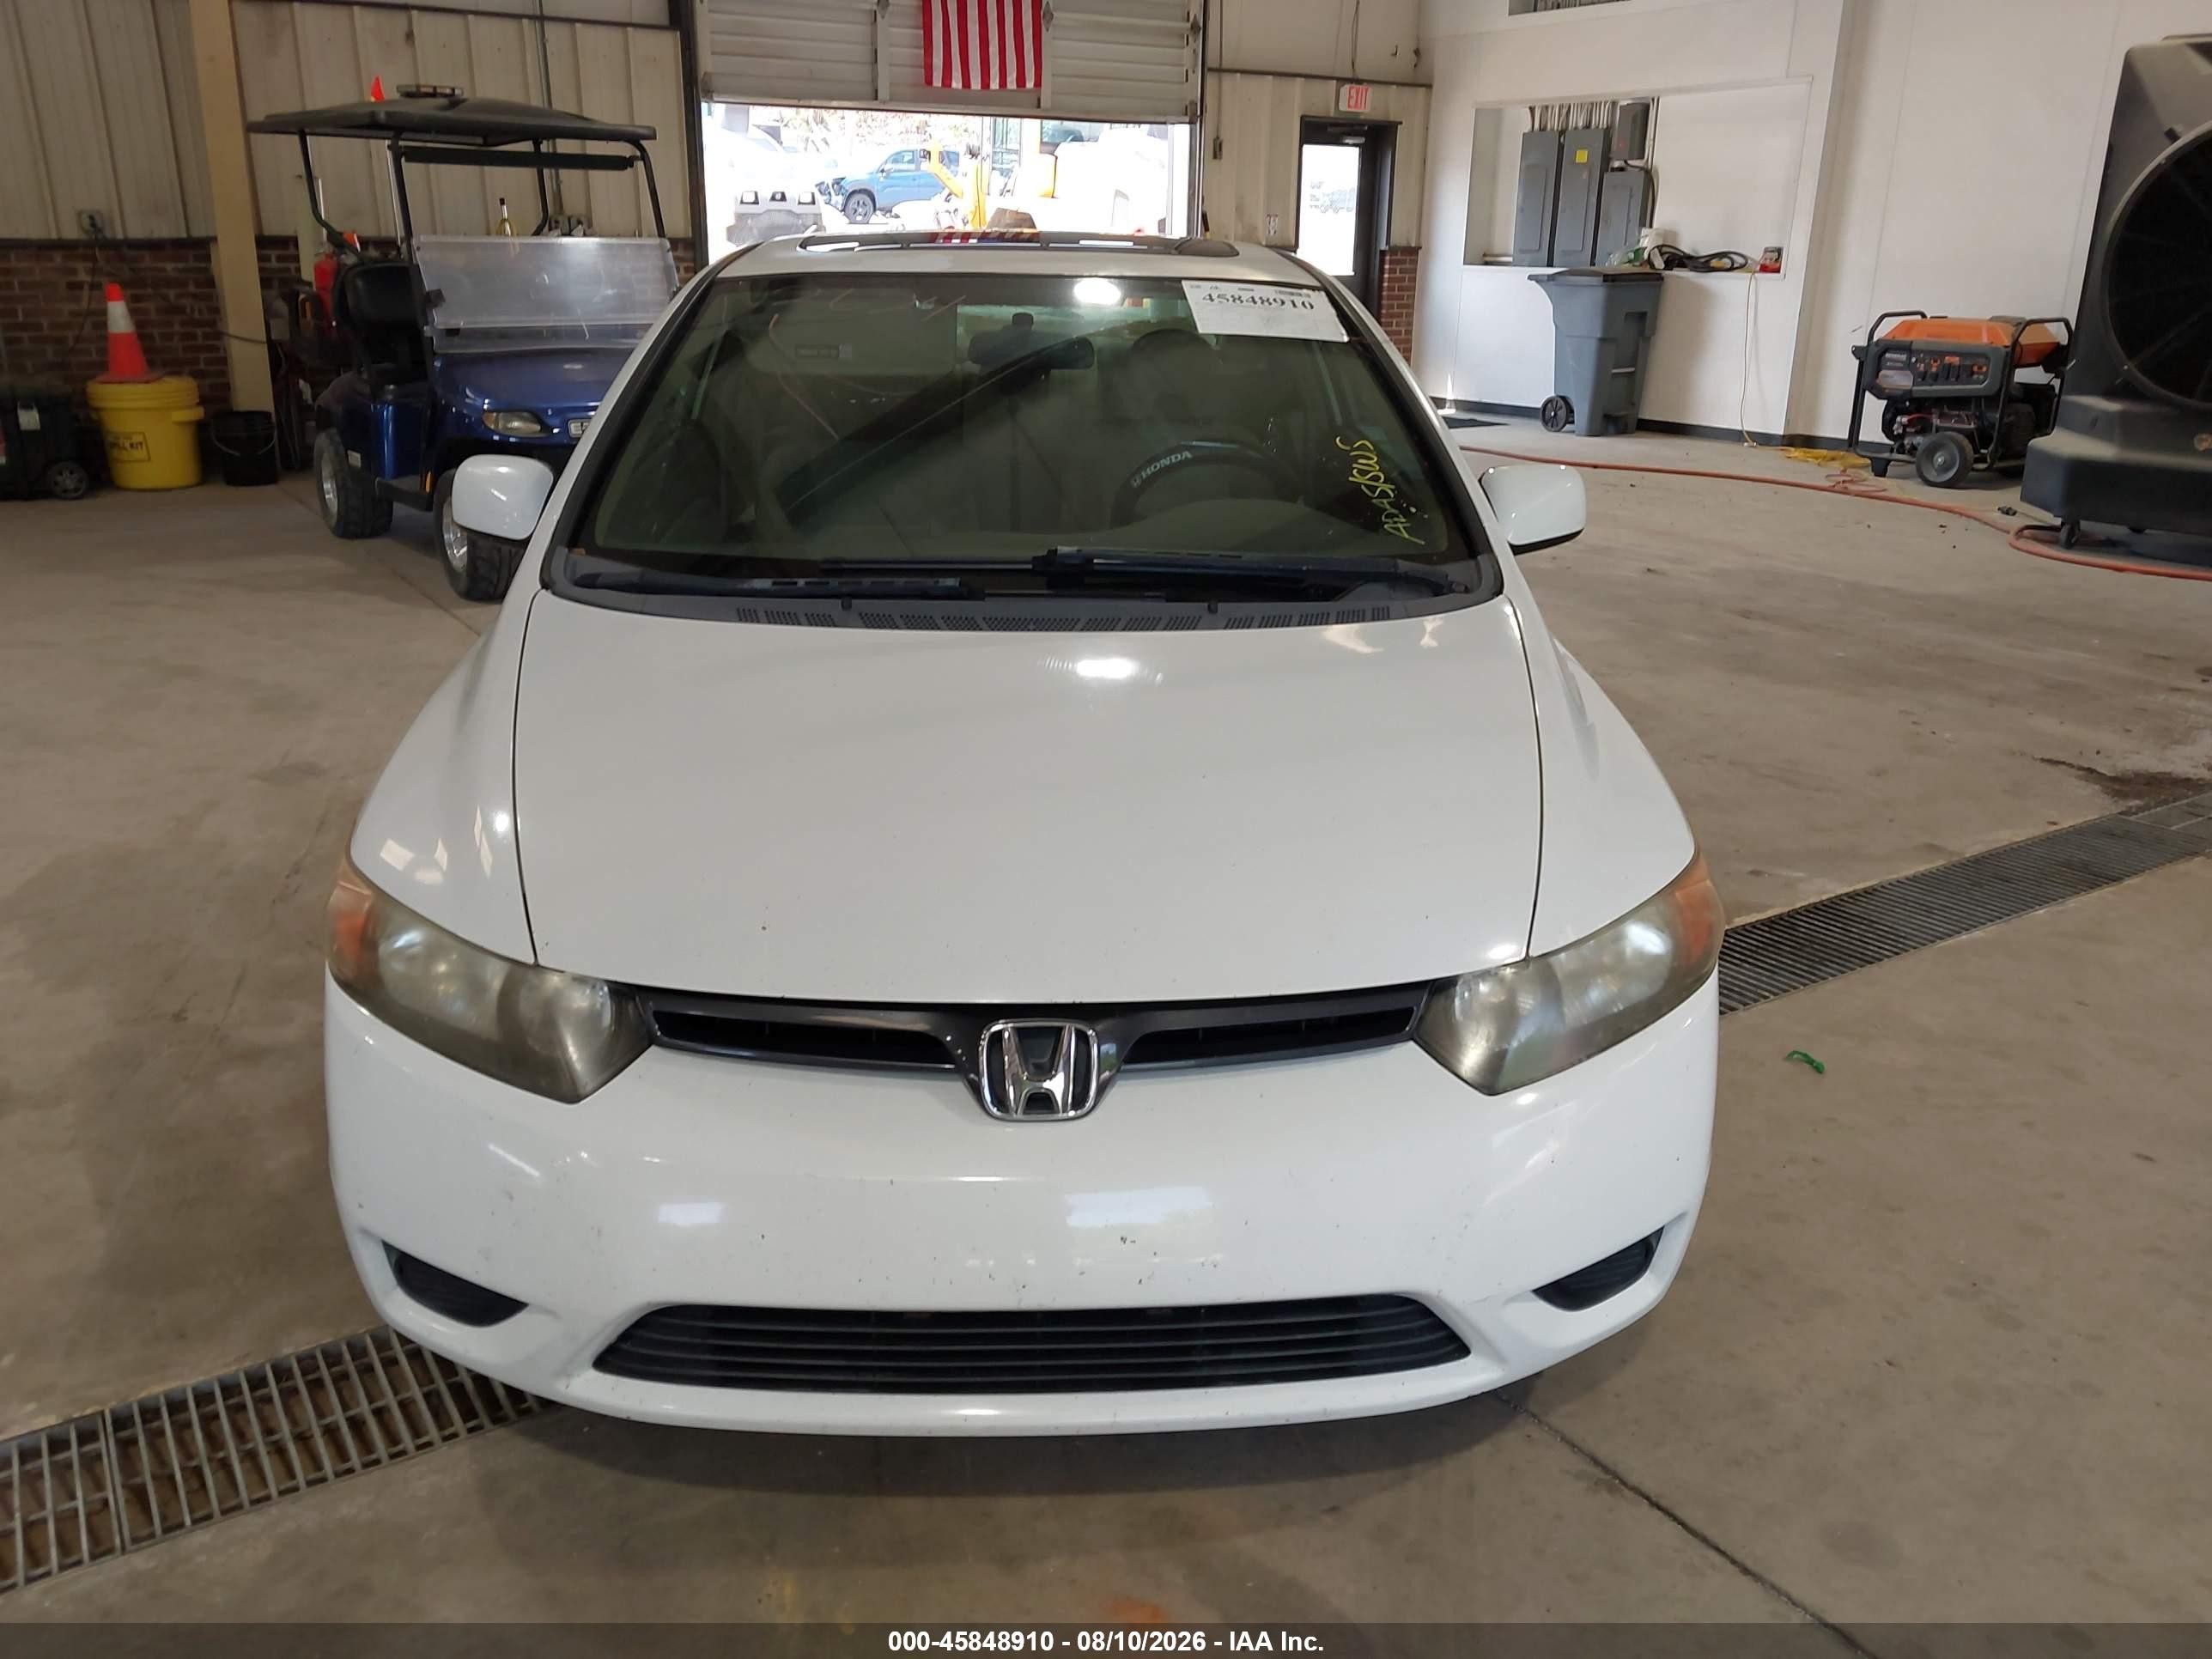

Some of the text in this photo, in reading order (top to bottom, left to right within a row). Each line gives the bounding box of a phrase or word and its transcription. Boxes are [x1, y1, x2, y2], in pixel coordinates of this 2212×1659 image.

[1347, 85, 1369, 110] EXIT
[1202, 293, 1315, 310] 45848910
[1141, 450, 1193, 479] HONDA
